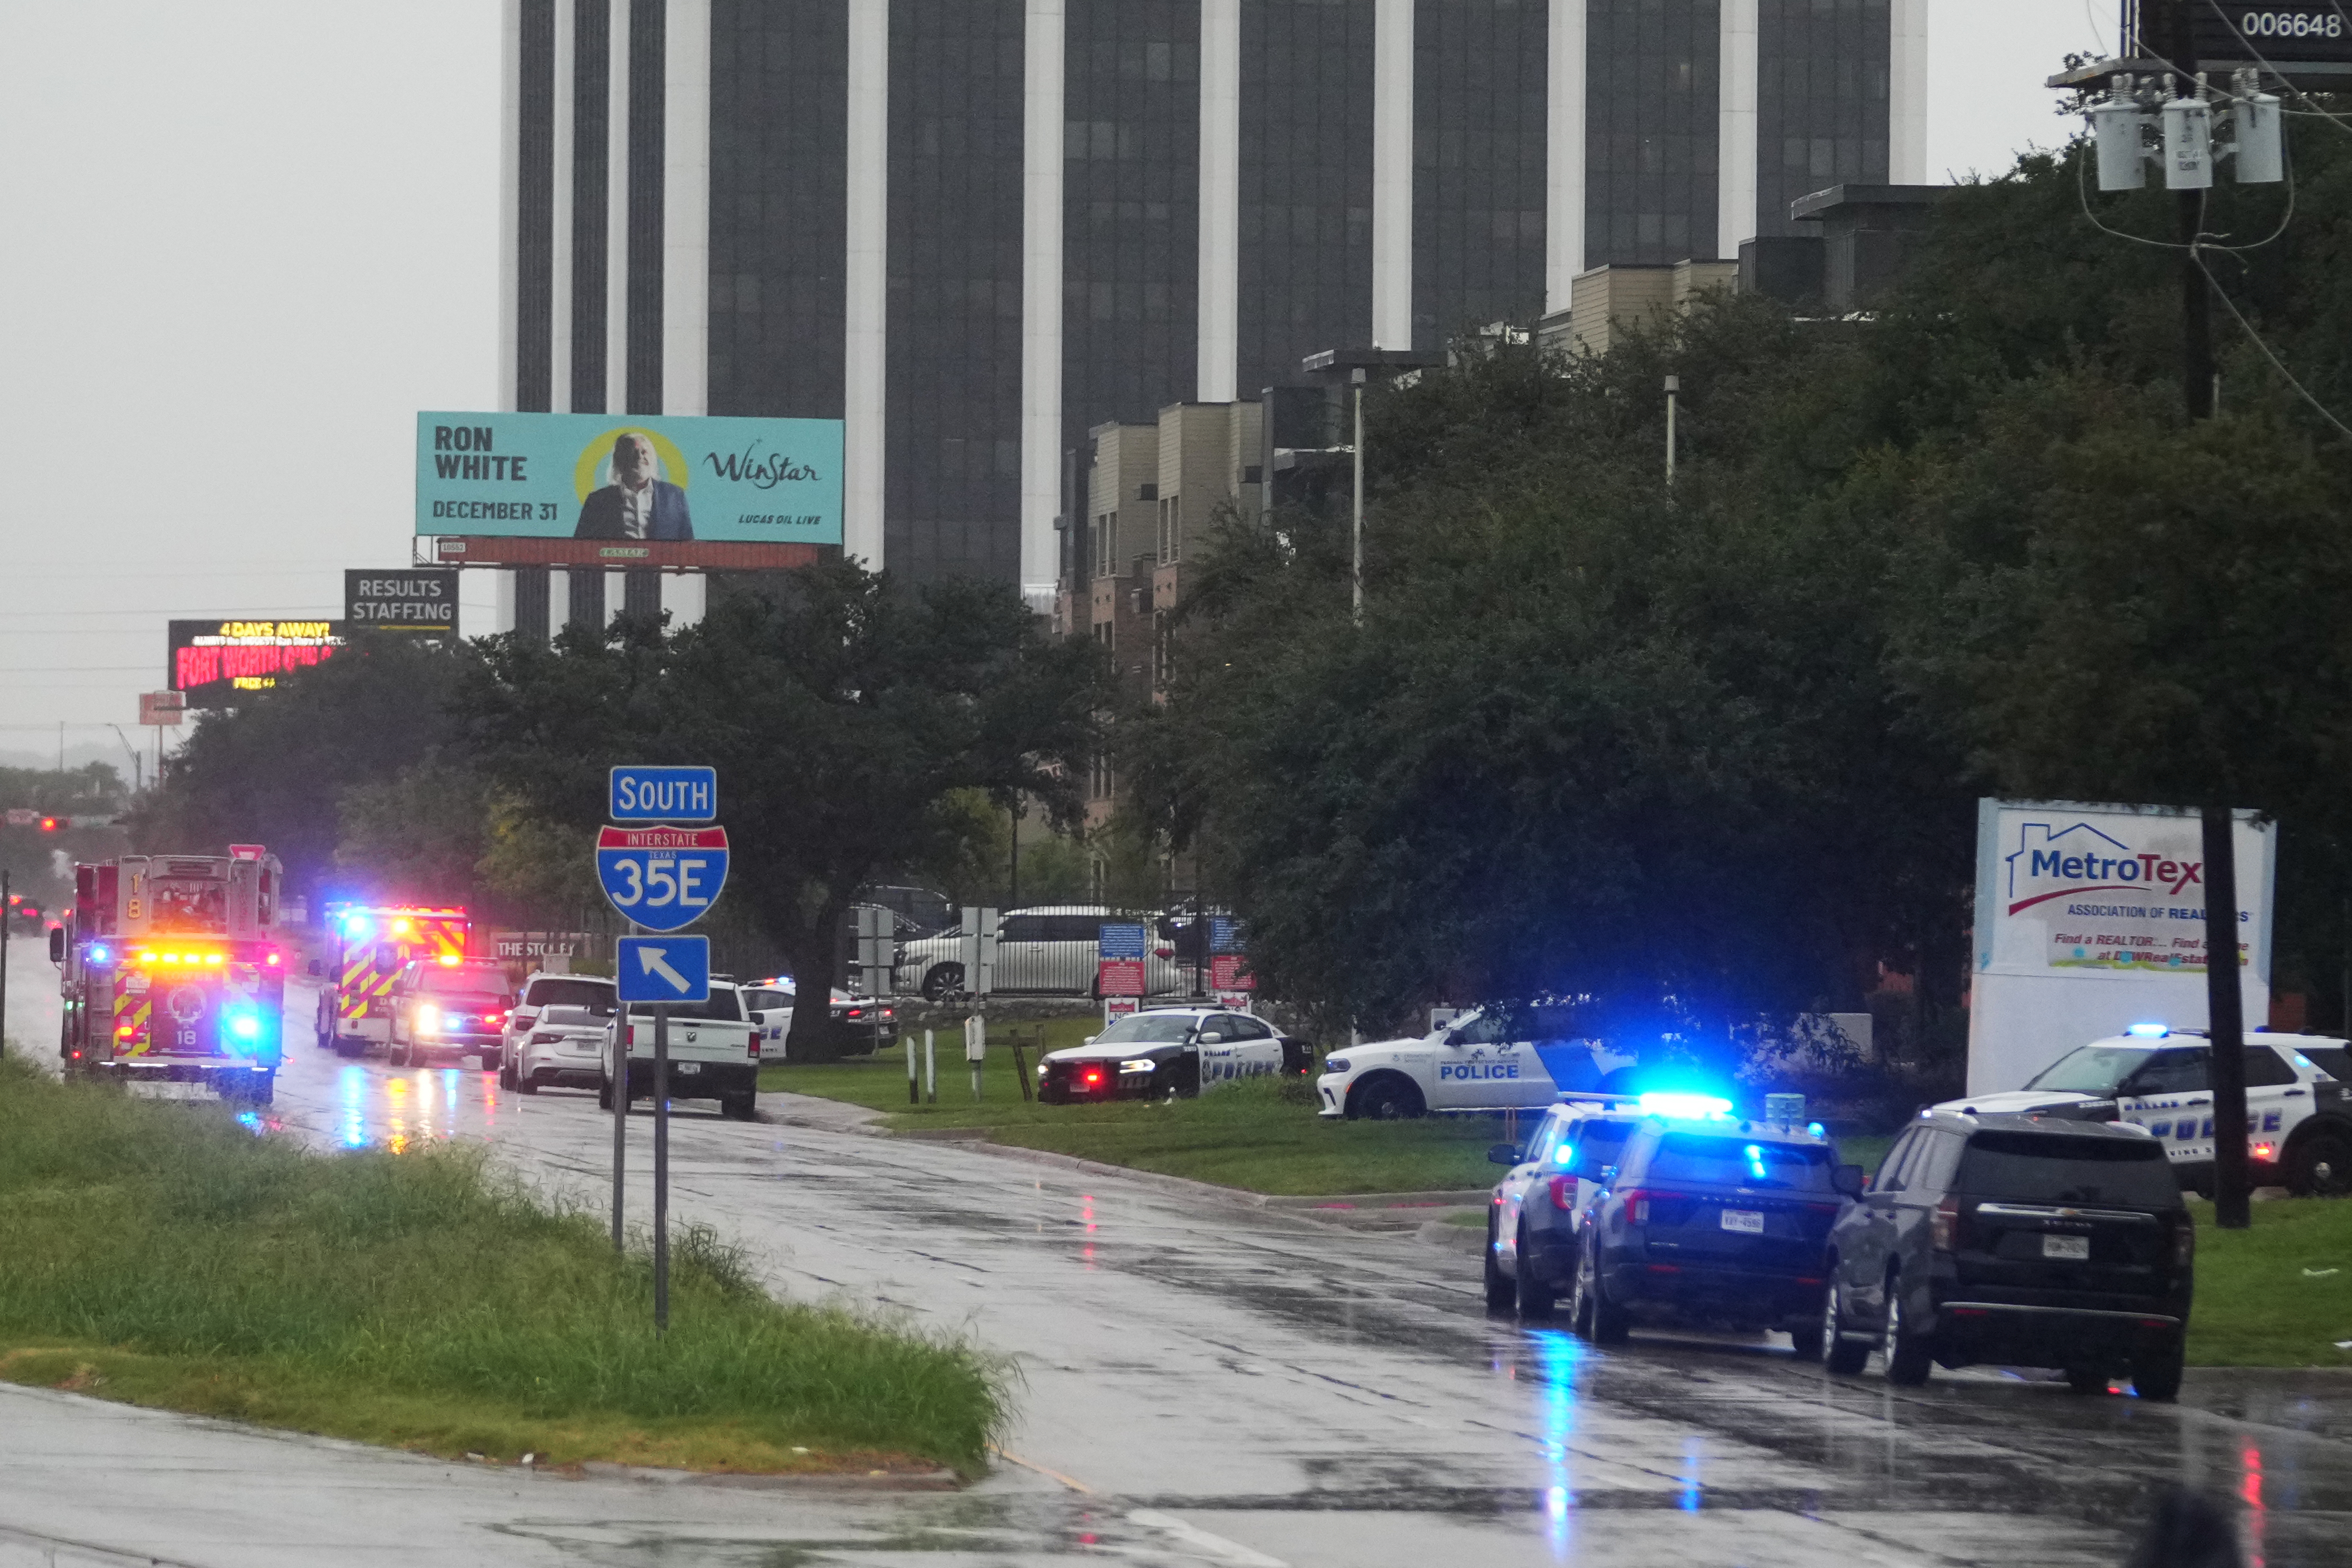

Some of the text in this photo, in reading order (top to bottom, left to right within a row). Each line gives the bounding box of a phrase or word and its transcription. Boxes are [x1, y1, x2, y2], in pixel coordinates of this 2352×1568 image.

[2243, 12, 2341, 37] 006648
[434, 425, 493, 452] RON
[434, 454, 528, 481] WHITE
[702, 442, 823, 490] WinStar
[433, 500, 557, 520] DECEMBER 31
[738, 514, 822, 525] LUCAS OIL LIVE
[358, 579, 443, 597] RESULTS
[352, 601, 453, 621] STAFFING
[218, 622, 331, 637] 4 DAYS AWAY!
[176, 645, 221, 690] FORT
[221, 645, 281, 680] WORTH
[619, 776, 708, 811] SOUTH
[627, 832, 699, 846] INTERSTATE
[649, 850, 677, 859] TEXAS
[2030, 848, 2204, 895] MetroTex
[613, 858, 709, 907] 35E
[2067, 904, 2249, 922] ASSOCIATION OF REALS
[498, 942, 525, 957] THE
[2054, 933, 2083, 944] Find
[2084, 936, 2093, 945] a
[2172, 937, 2200, 949] Find
[2097, 950, 2111, 961] at
[177, 1030, 196, 1045] 18
[1441, 1064, 1520, 1080] POLICE
[2124, 1100, 2180, 1111] DALLAS
[2150, 1107, 2283, 1141] POLCE
